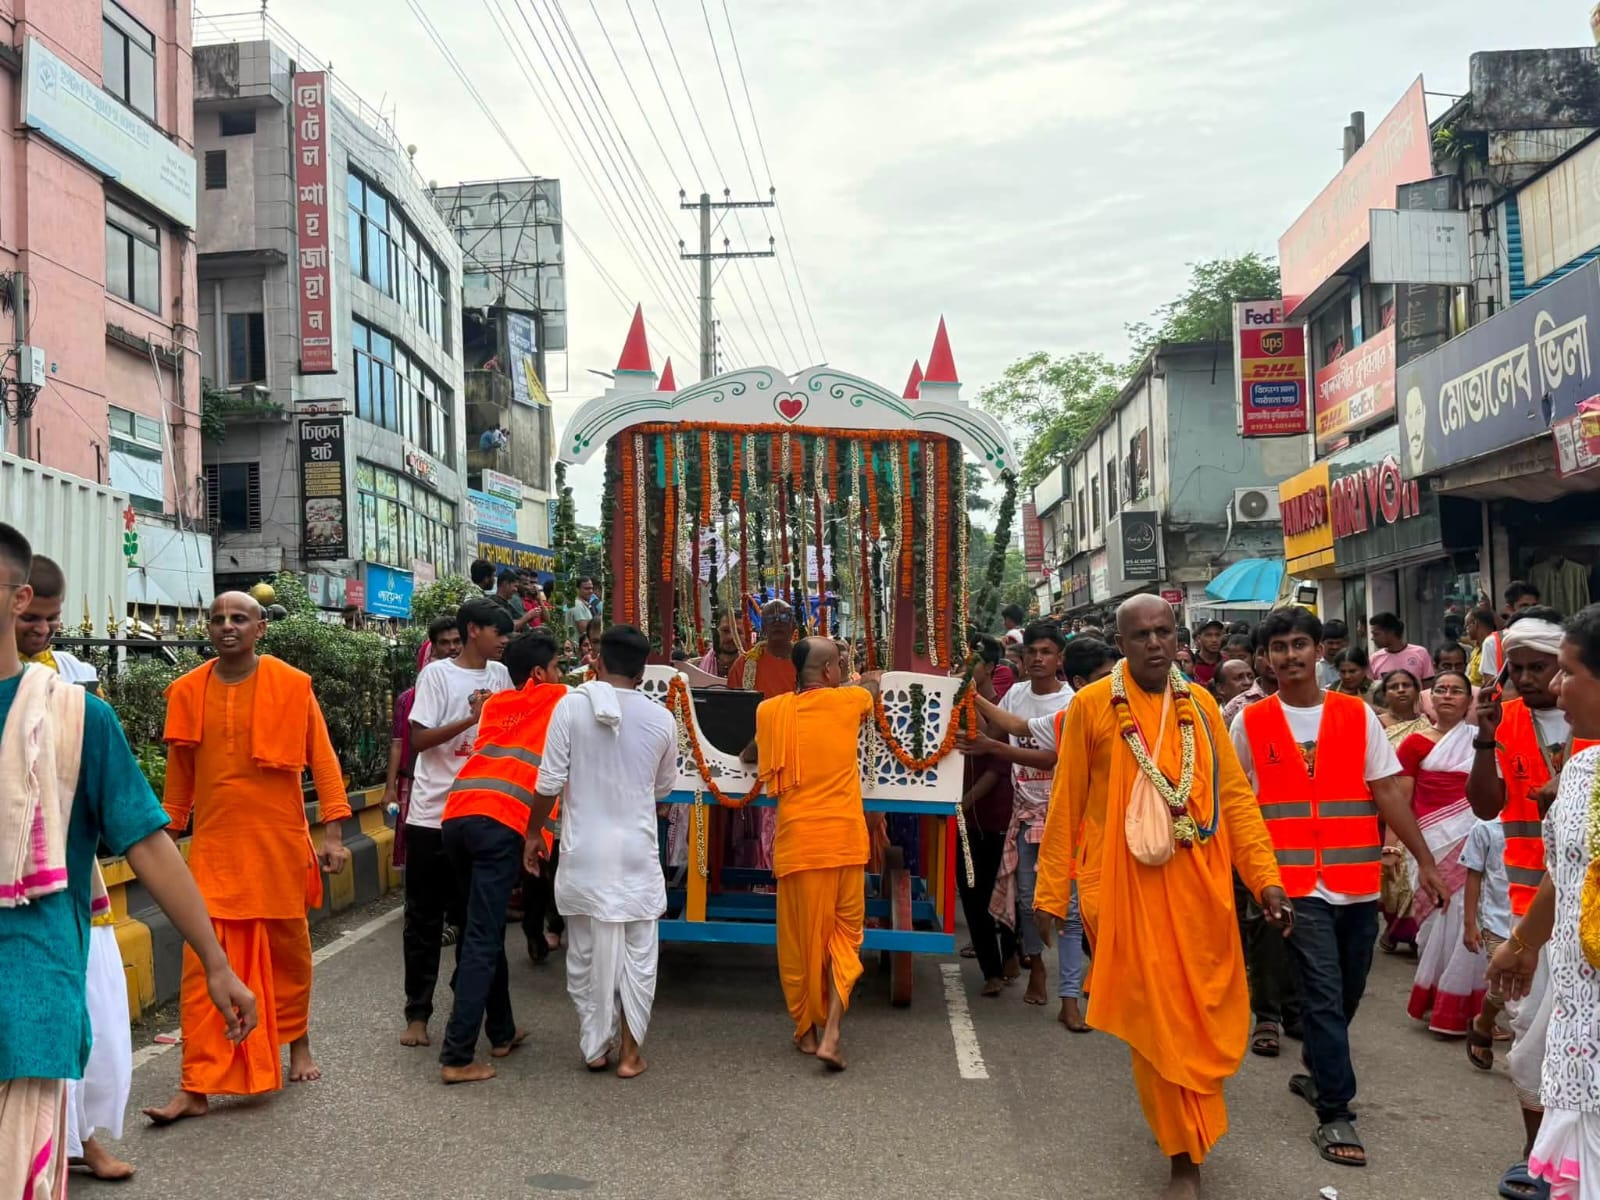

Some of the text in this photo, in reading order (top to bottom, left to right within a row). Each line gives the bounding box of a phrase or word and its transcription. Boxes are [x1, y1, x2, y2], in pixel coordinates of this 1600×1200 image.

[297, 82, 322, 166] হোটেল
[299, 182, 327, 332] শাহজাহান
[1245, 307, 1283, 325] FedE
[1262, 337, 1283, 352] ups
[1534, 310, 1591, 394] ভিলা
[1252, 363, 1298, 378] DHL
[1348, 391, 1374, 422] FedEx
[301, 421, 340, 442] চিকেন
[310, 442, 333, 461] হাট
